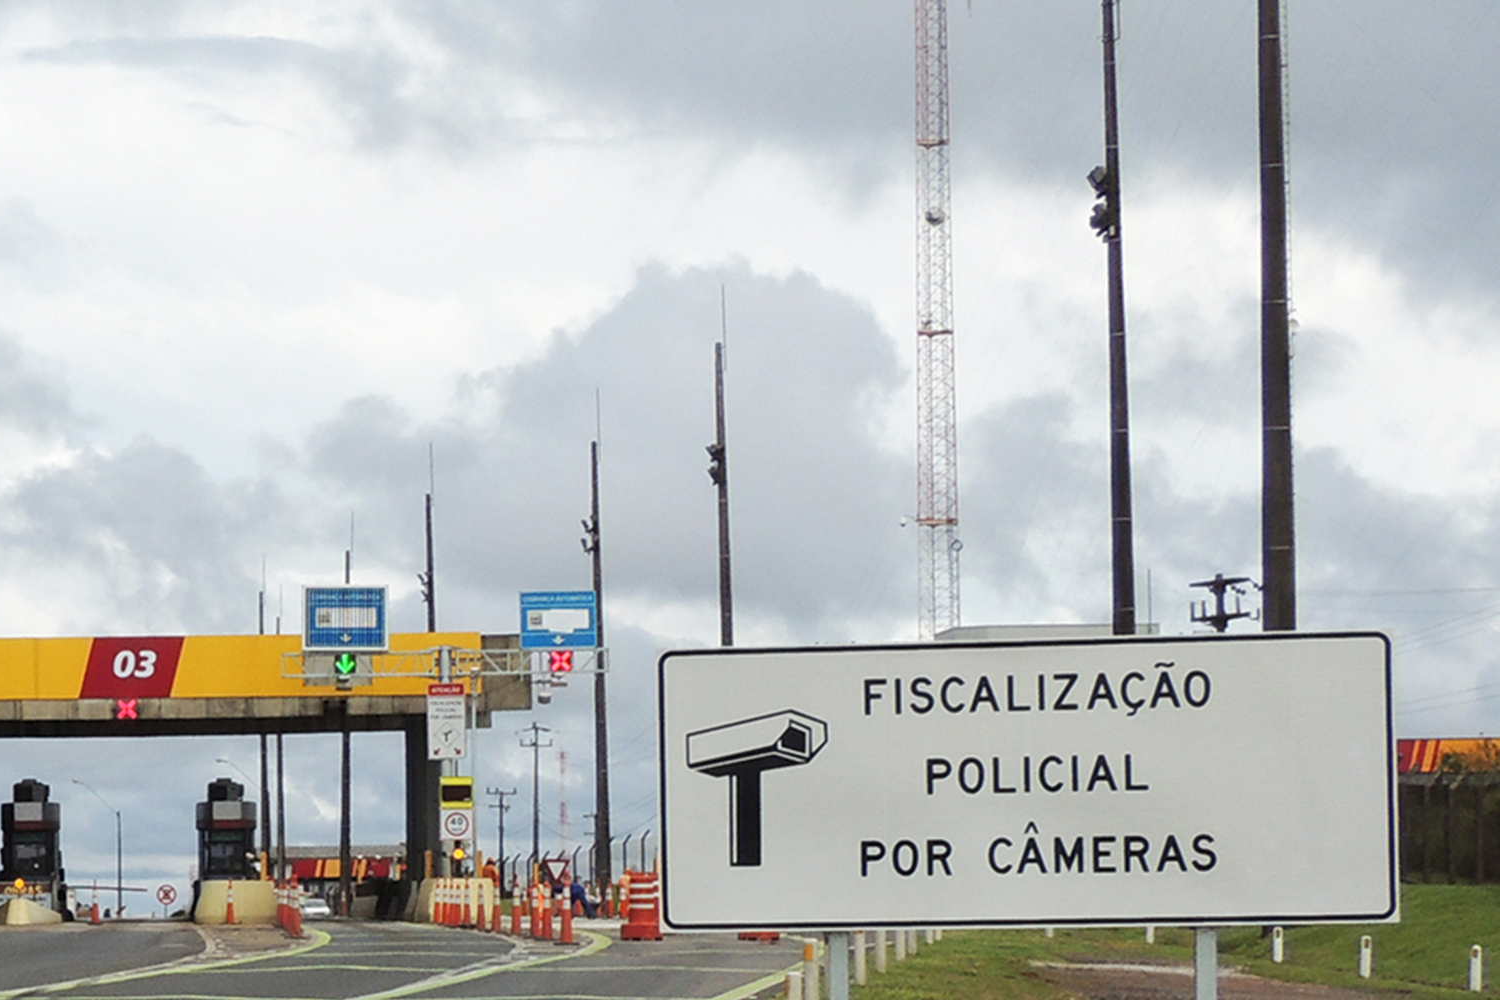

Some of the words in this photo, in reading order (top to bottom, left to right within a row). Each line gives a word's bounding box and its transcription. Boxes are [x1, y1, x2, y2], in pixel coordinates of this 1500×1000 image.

[113, 650, 157, 678] 03
[863, 661, 1211, 717] FISCALIZAÇÃO
[926, 753, 1149, 797] POLICIAL
[450, 816, 464, 826] 40
[860, 834, 954, 878] POR
[988, 821, 1217, 876] CÂMERAS
